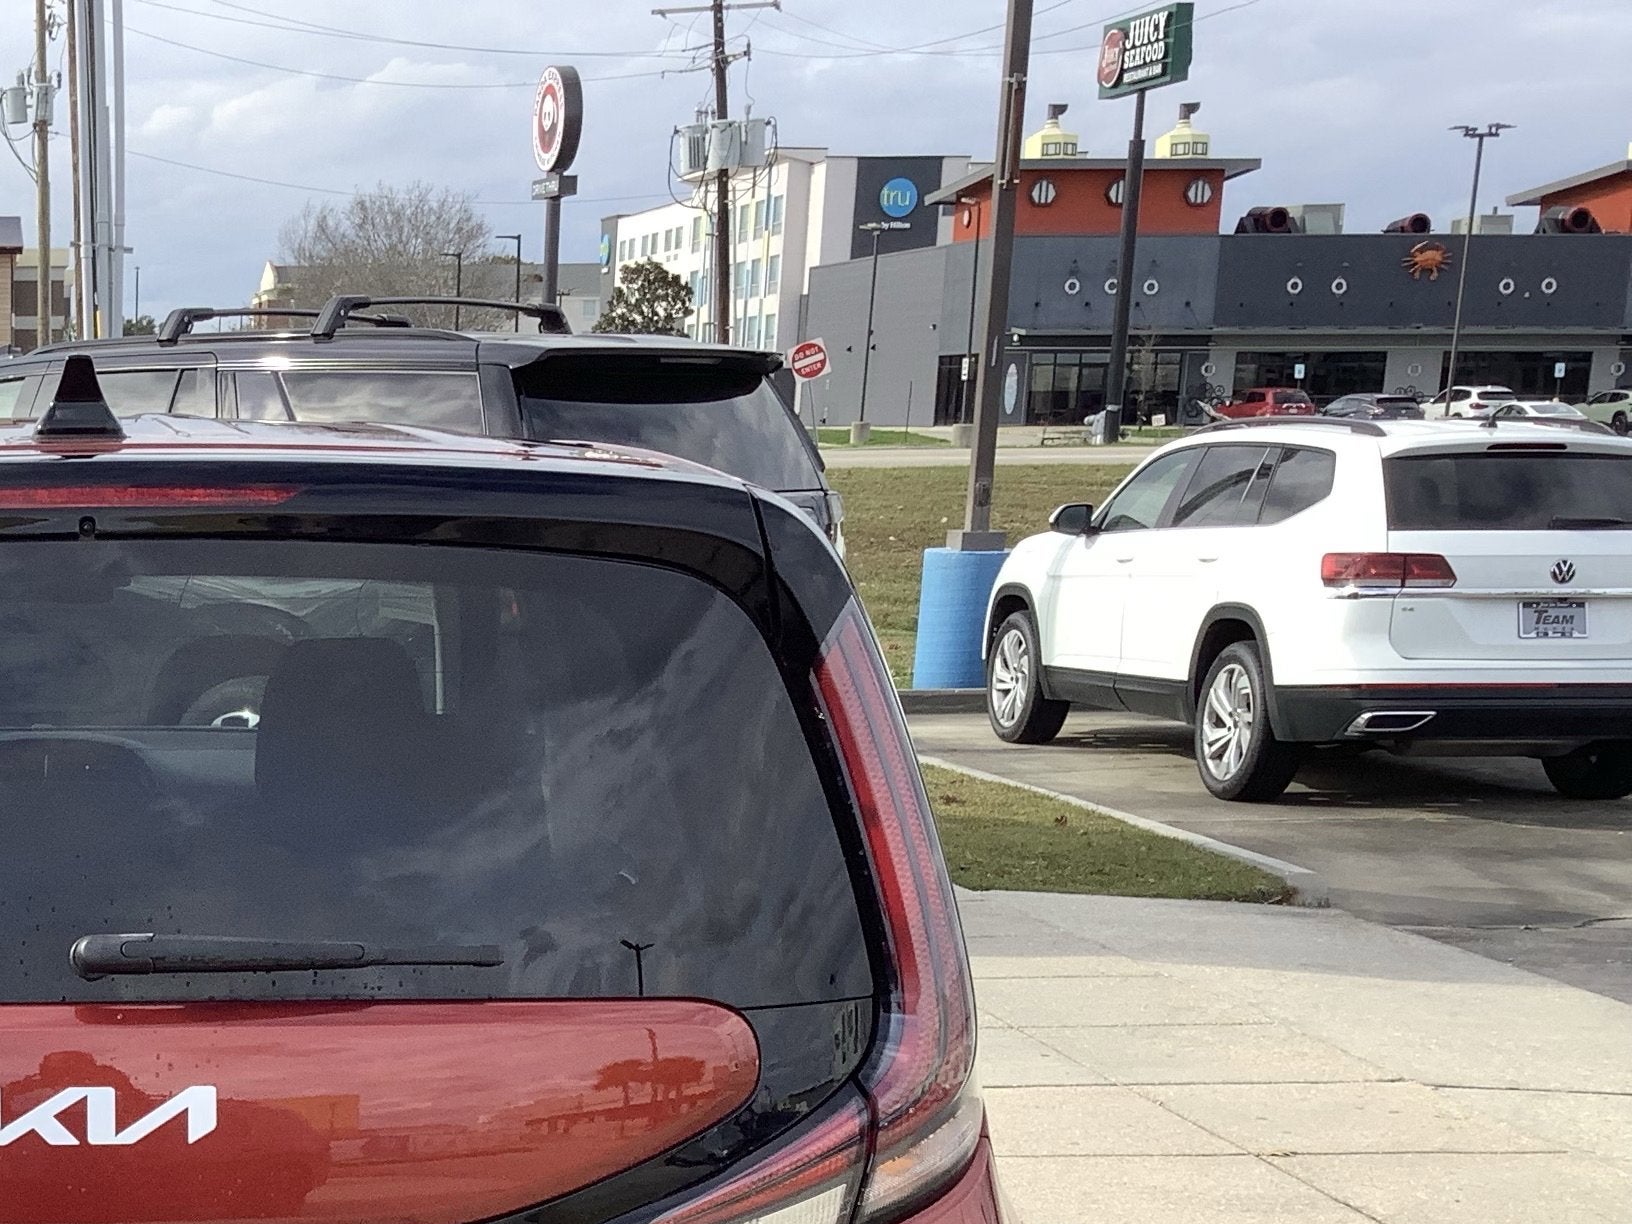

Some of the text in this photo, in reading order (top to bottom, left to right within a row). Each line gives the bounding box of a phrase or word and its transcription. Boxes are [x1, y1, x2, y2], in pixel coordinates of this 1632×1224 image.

[1125, 10, 1168, 49] JUICY
[1123, 41, 1165, 69] SEAFOOD
[883, 187, 911, 207] tru
[794, 346, 819, 360] DO NOT
[801, 361, 822, 375] ENTER
[1533, 609, 1575, 625] TEAM
